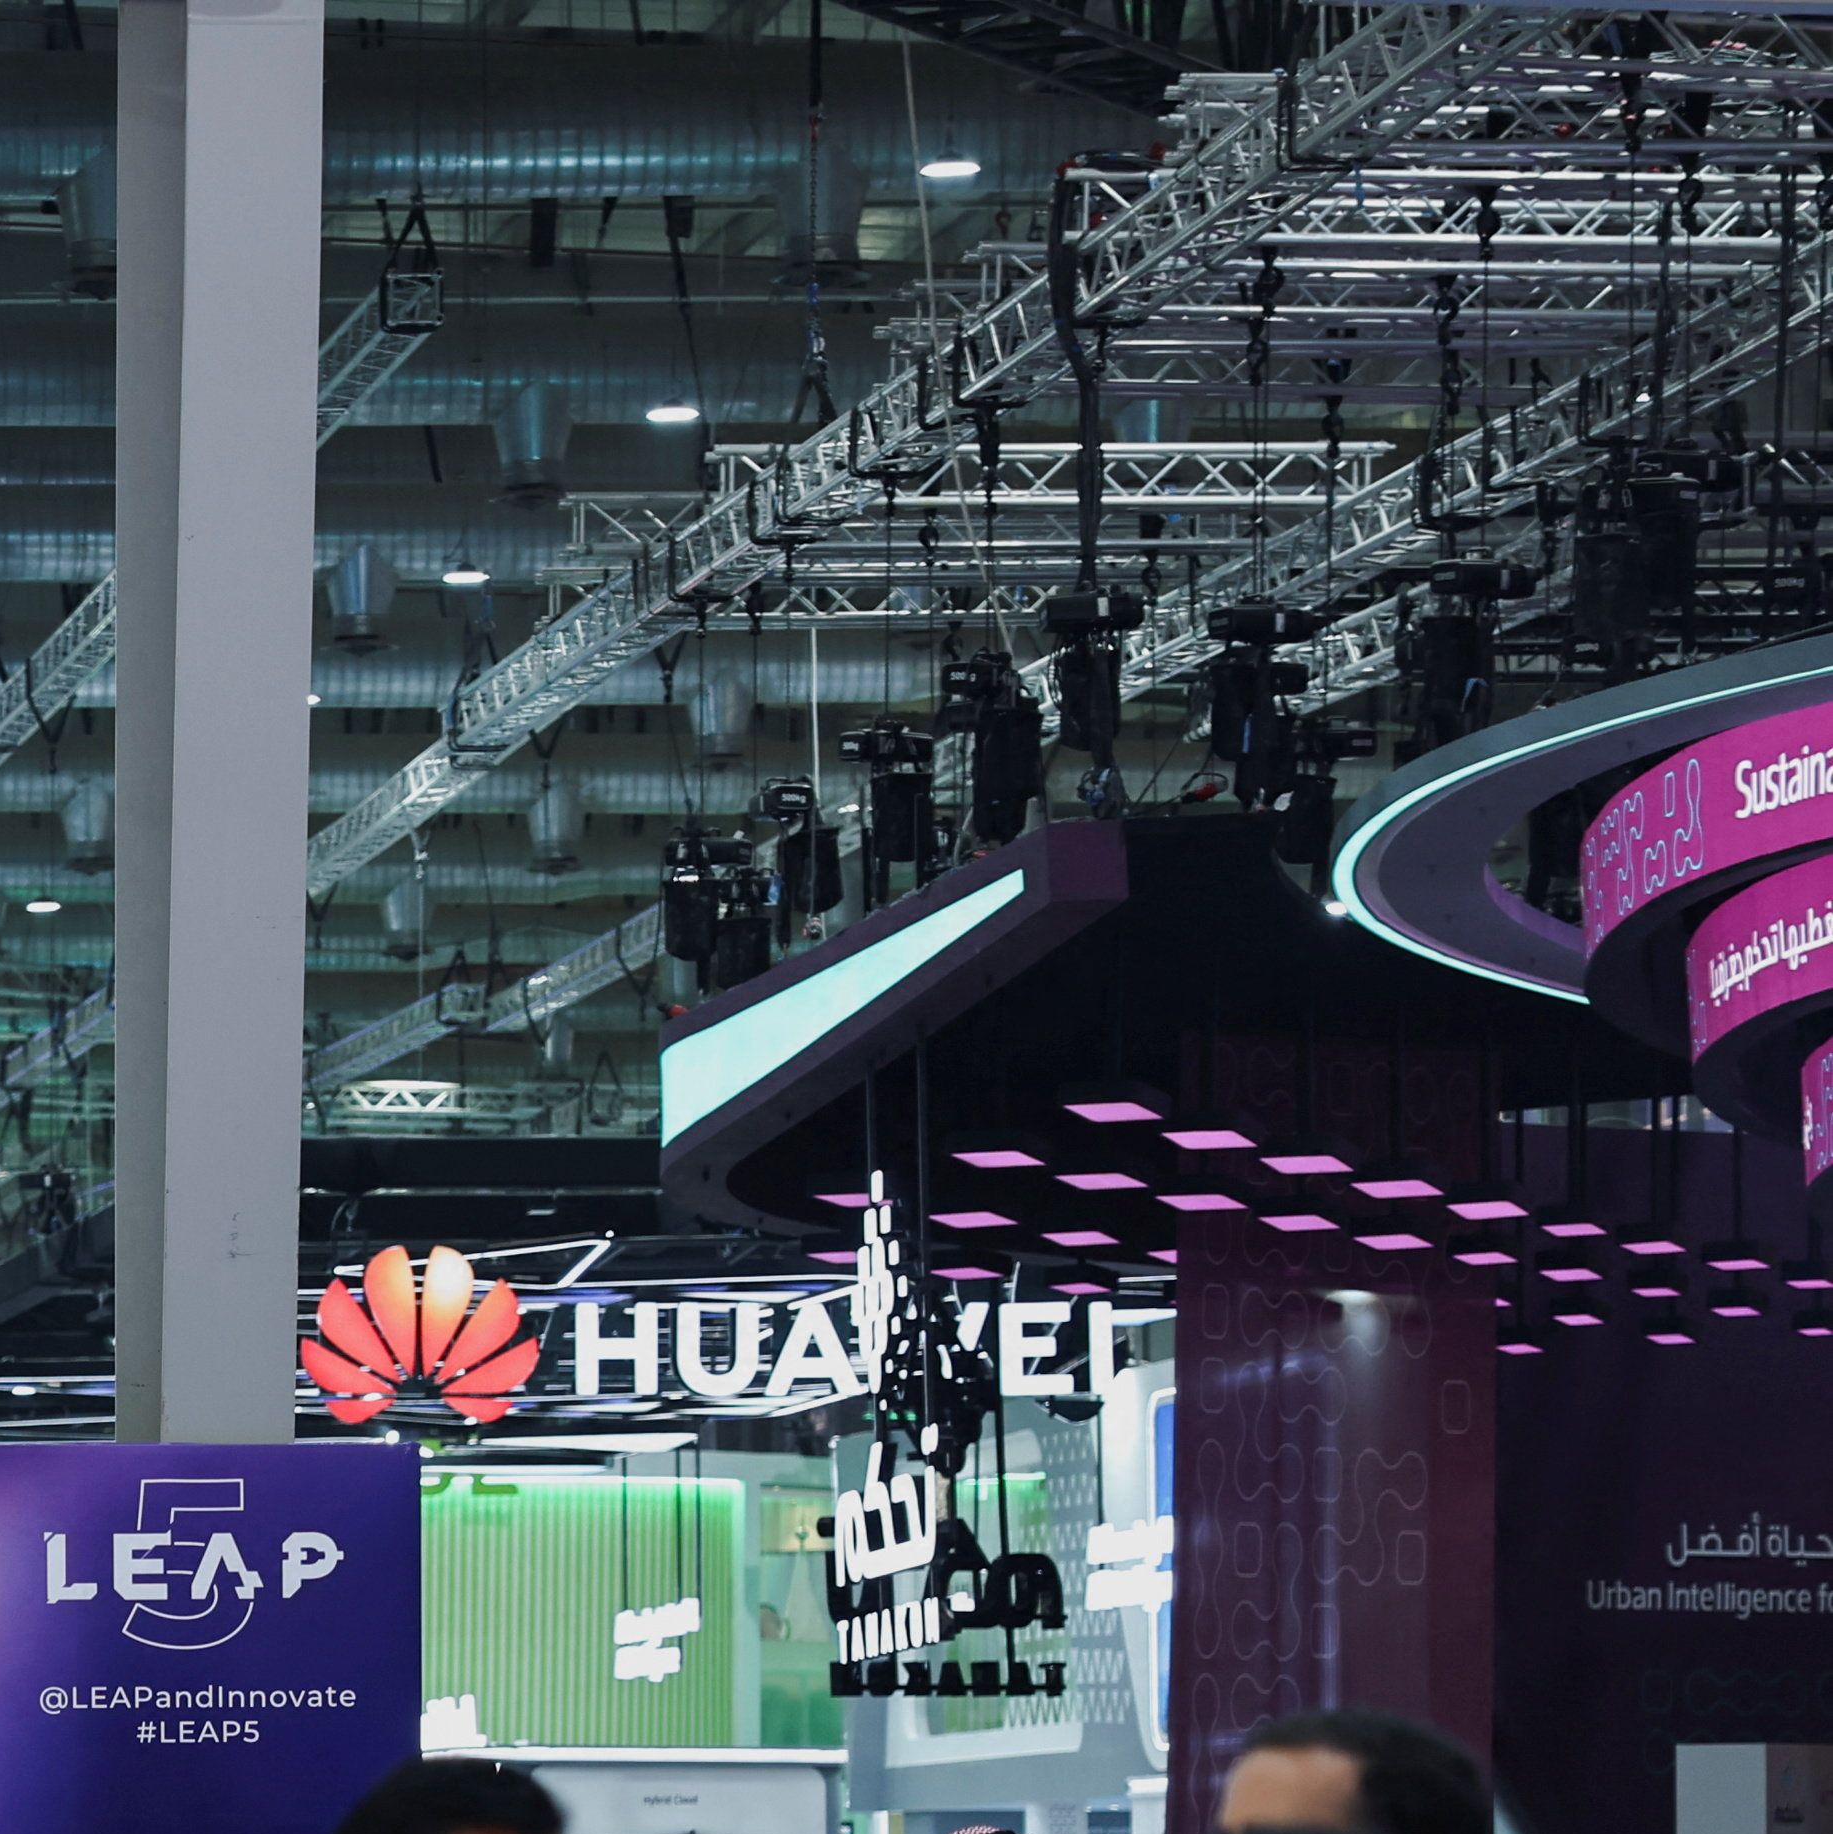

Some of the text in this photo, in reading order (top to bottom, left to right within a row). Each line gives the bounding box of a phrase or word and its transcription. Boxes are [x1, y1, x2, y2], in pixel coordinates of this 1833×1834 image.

[44, 1531, 345, 1604] LEAP
[1587, 1580, 1662, 1611] Urban
[1667, 1580, 1812, 1620] Intelligence
[39, 1684, 356, 1714] @LEAPandInnovate
[136, 1720, 260, 1744] #LEAP5
